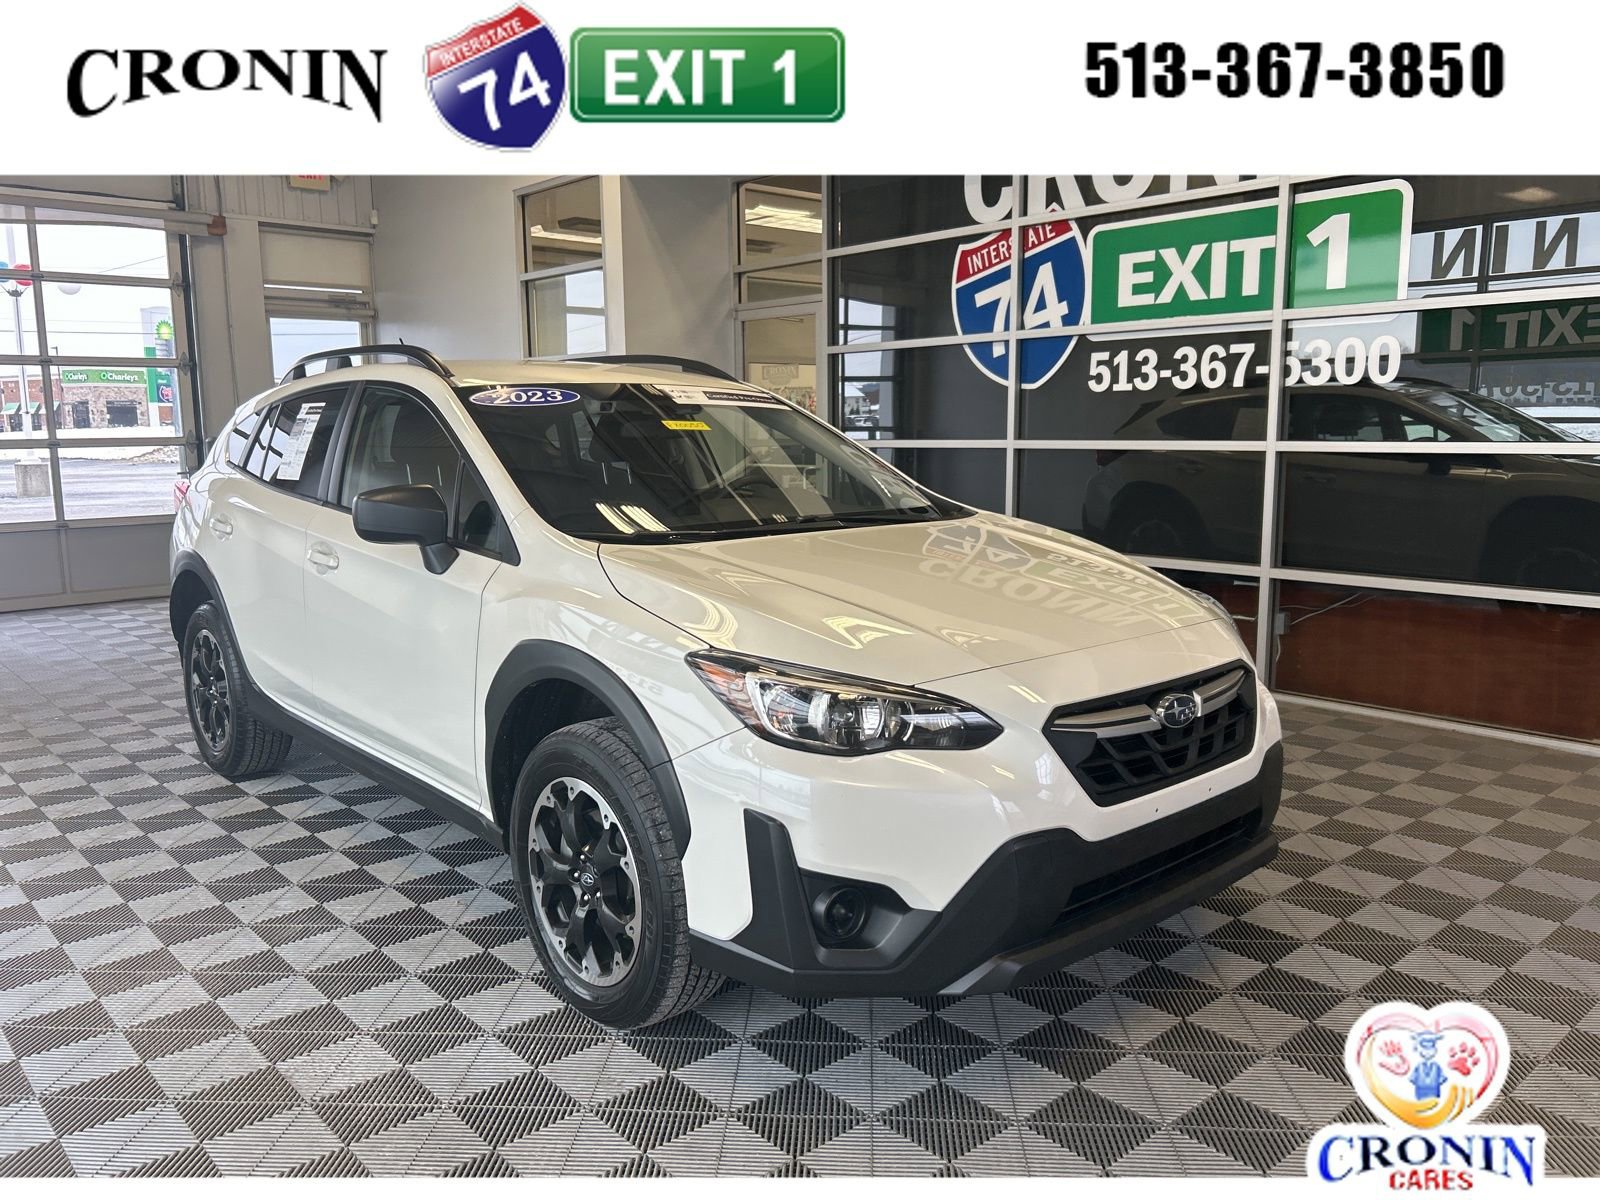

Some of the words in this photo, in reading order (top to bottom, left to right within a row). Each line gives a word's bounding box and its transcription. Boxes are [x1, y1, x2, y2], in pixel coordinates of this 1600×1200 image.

[967, 223, 1056, 275] INTERATE
[1117, 235, 1276, 308] EXIT
[1306, 213, 1350, 290] 1
[974, 261, 1069, 358] 74
[1087, 335, 1401, 393] 513-367-5300
[494, 390, 563, 404] 2023
